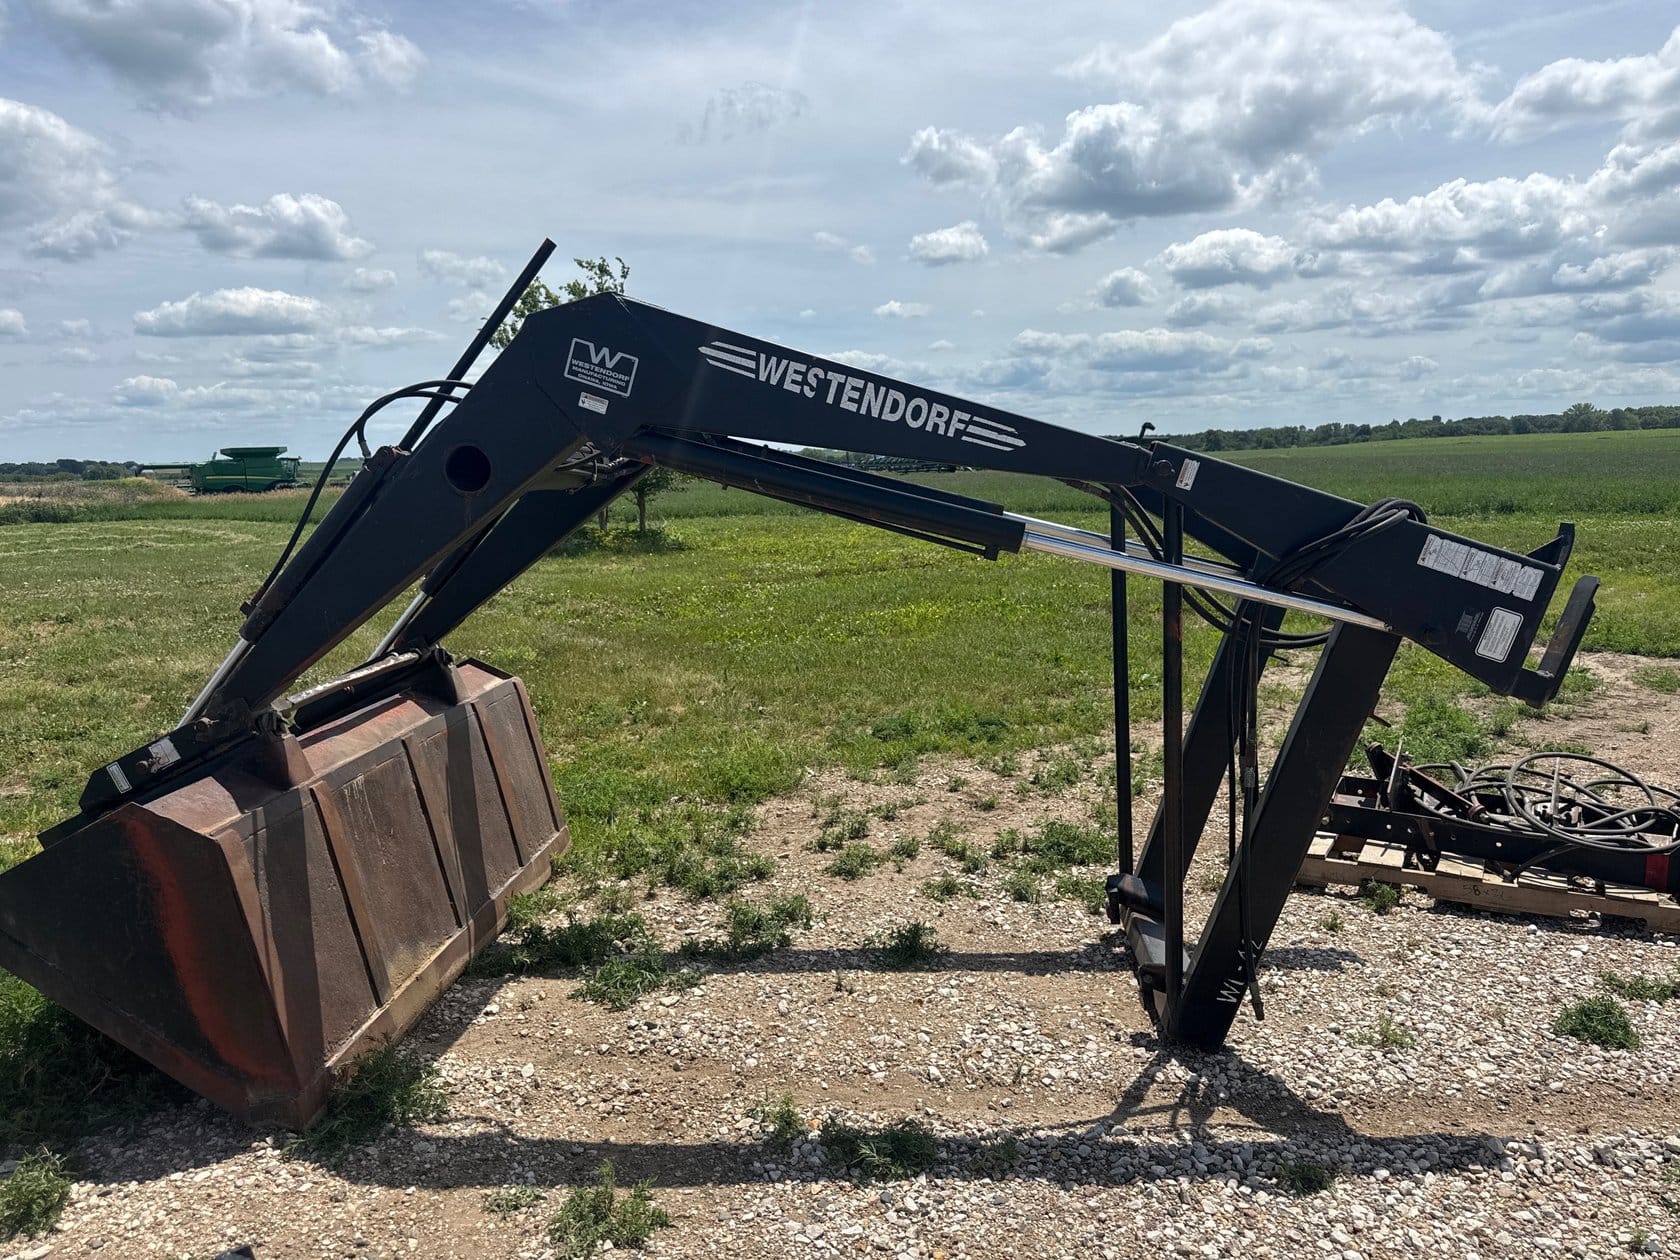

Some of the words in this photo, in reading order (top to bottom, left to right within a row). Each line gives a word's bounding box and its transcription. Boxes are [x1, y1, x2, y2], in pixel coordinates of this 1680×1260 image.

[571, 358, 630, 382] WESTENDORF
[572, 366, 626, 387] MANUFACTURING
[758, 353, 971, 437] WESTENDORF
